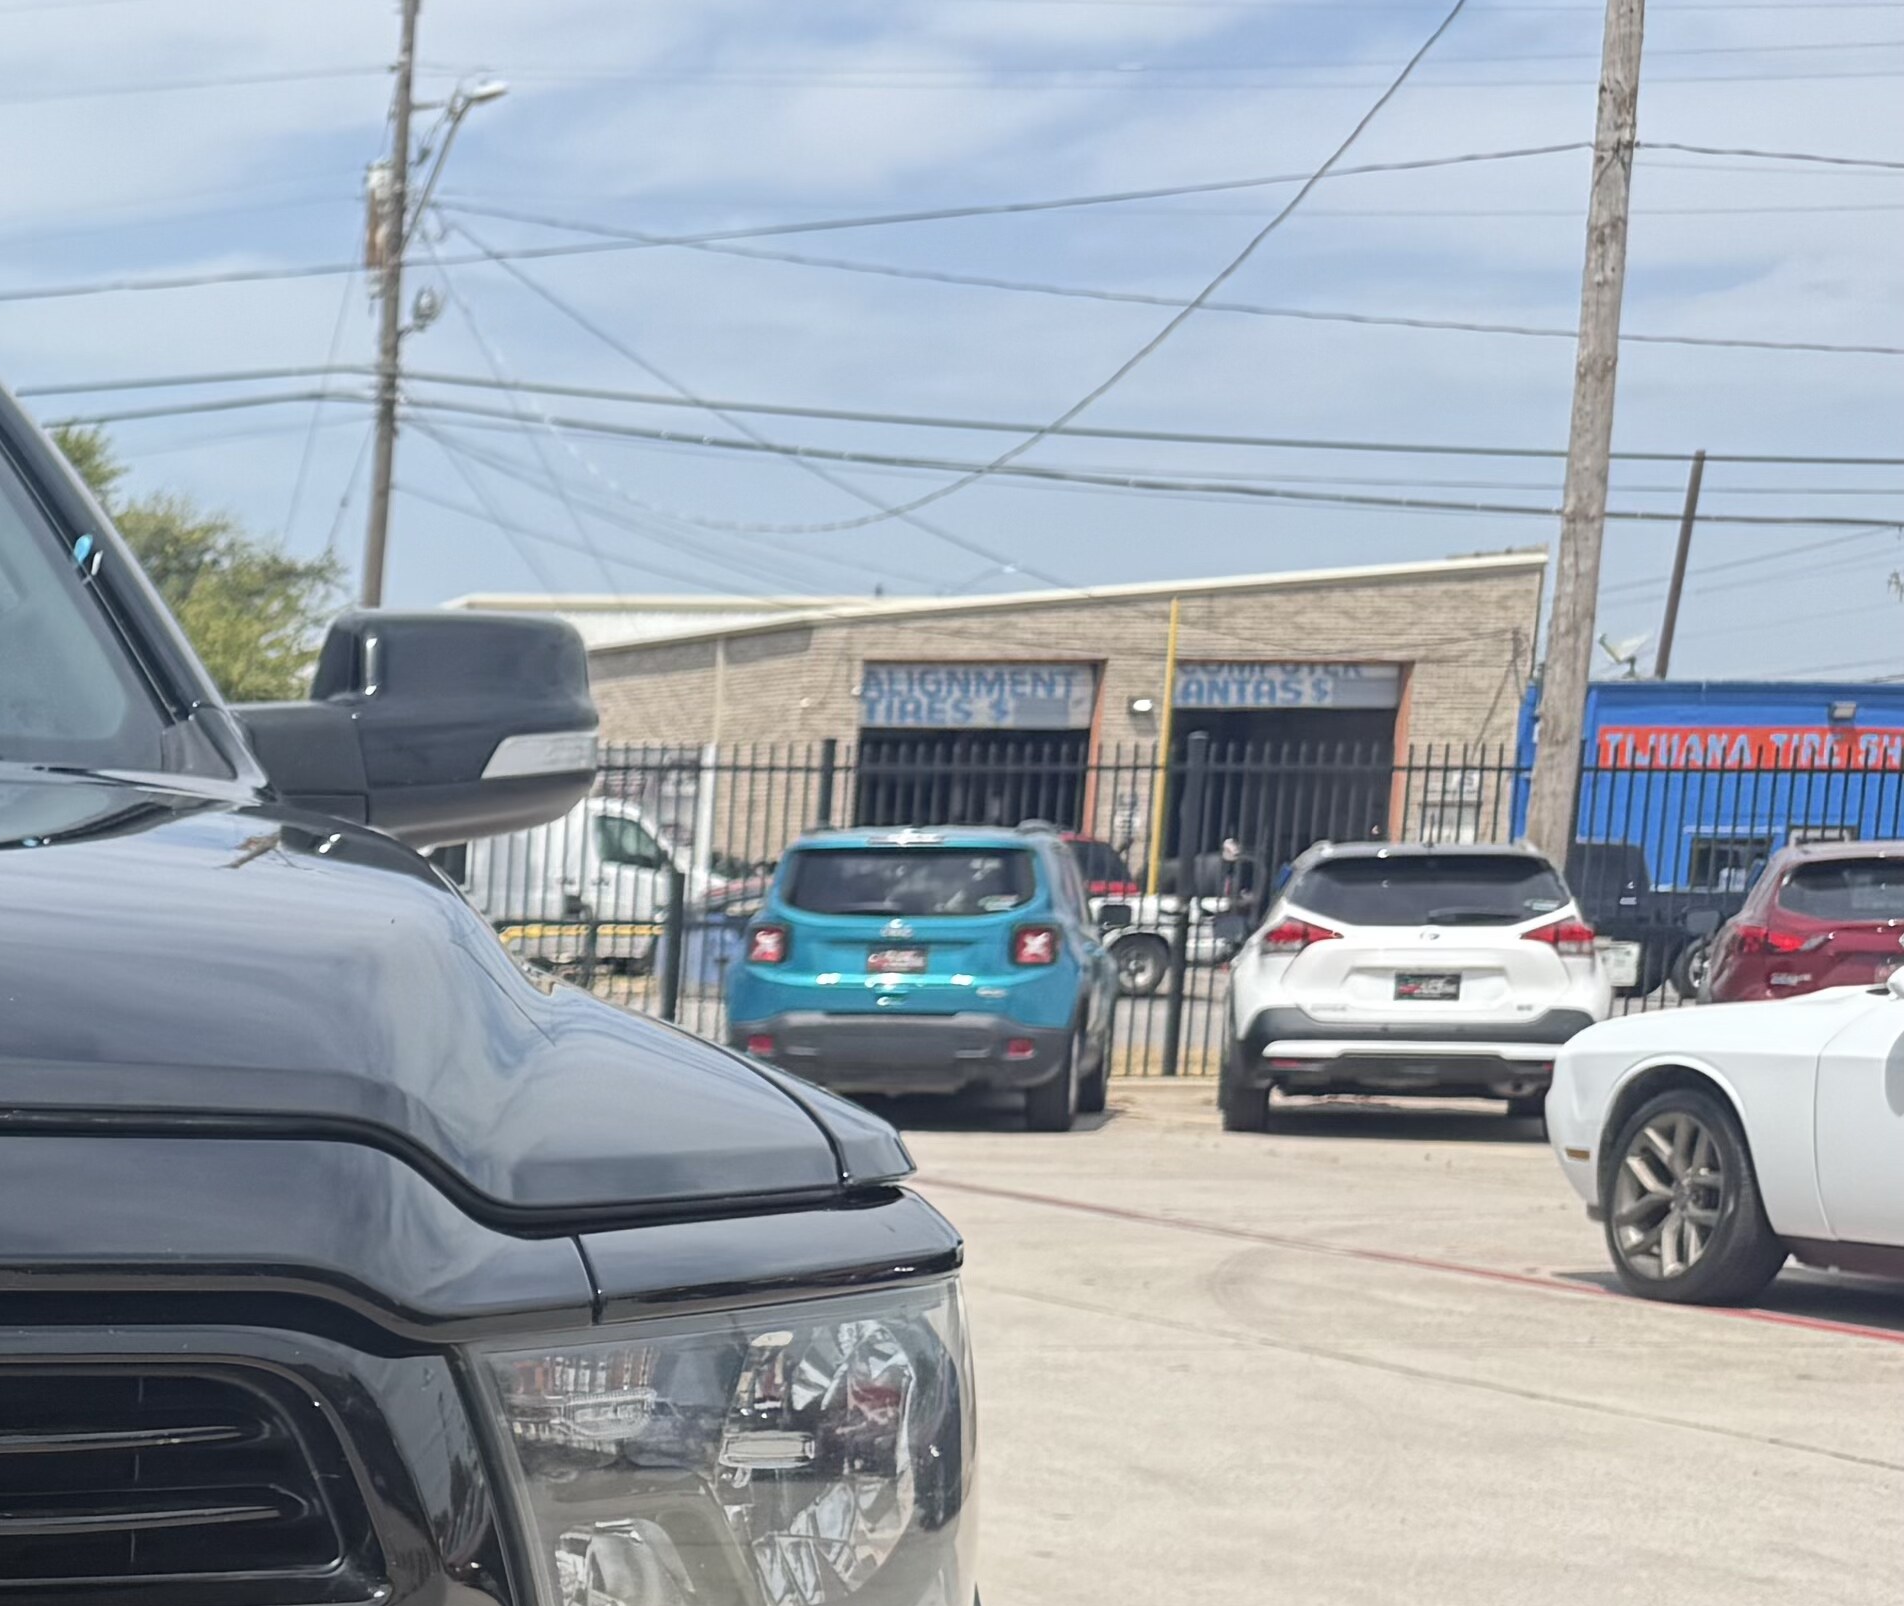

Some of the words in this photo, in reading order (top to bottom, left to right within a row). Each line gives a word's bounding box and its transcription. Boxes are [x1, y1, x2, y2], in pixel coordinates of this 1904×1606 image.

[861, 668, 1076, 699] ALIGNMENT
[864, 699, 974, 725] TIRES
[1605, 733, 1753, 767] TIJUANA
